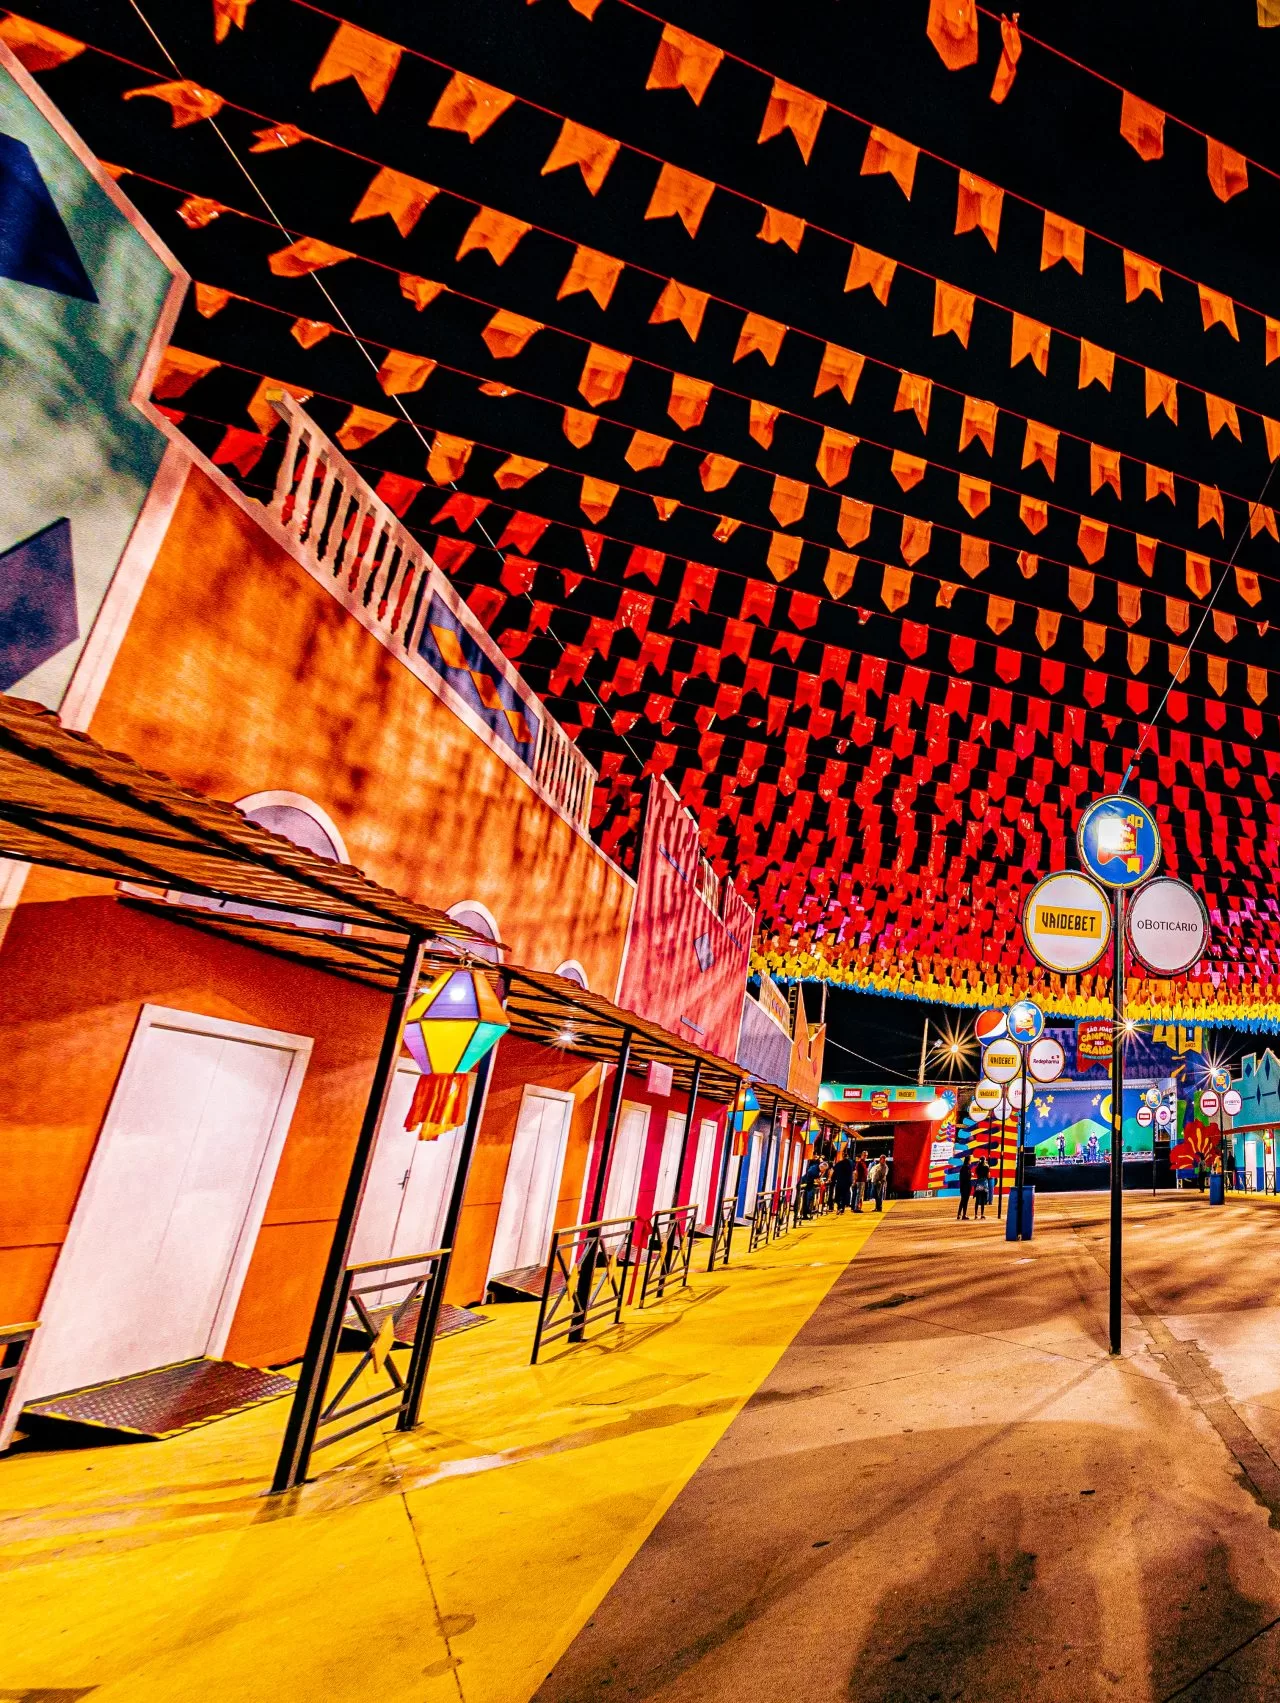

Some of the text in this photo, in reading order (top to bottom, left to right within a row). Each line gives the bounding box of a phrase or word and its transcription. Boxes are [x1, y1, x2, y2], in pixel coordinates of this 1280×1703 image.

[1041, 911, 1096, 932] VAIDEBET
[1081, 1032, 1113, 1042] CAMPIN
[1079, 1043, 1113, 1056] GRAND
[989, 1056, 1015, 1065] VAIDEBET
